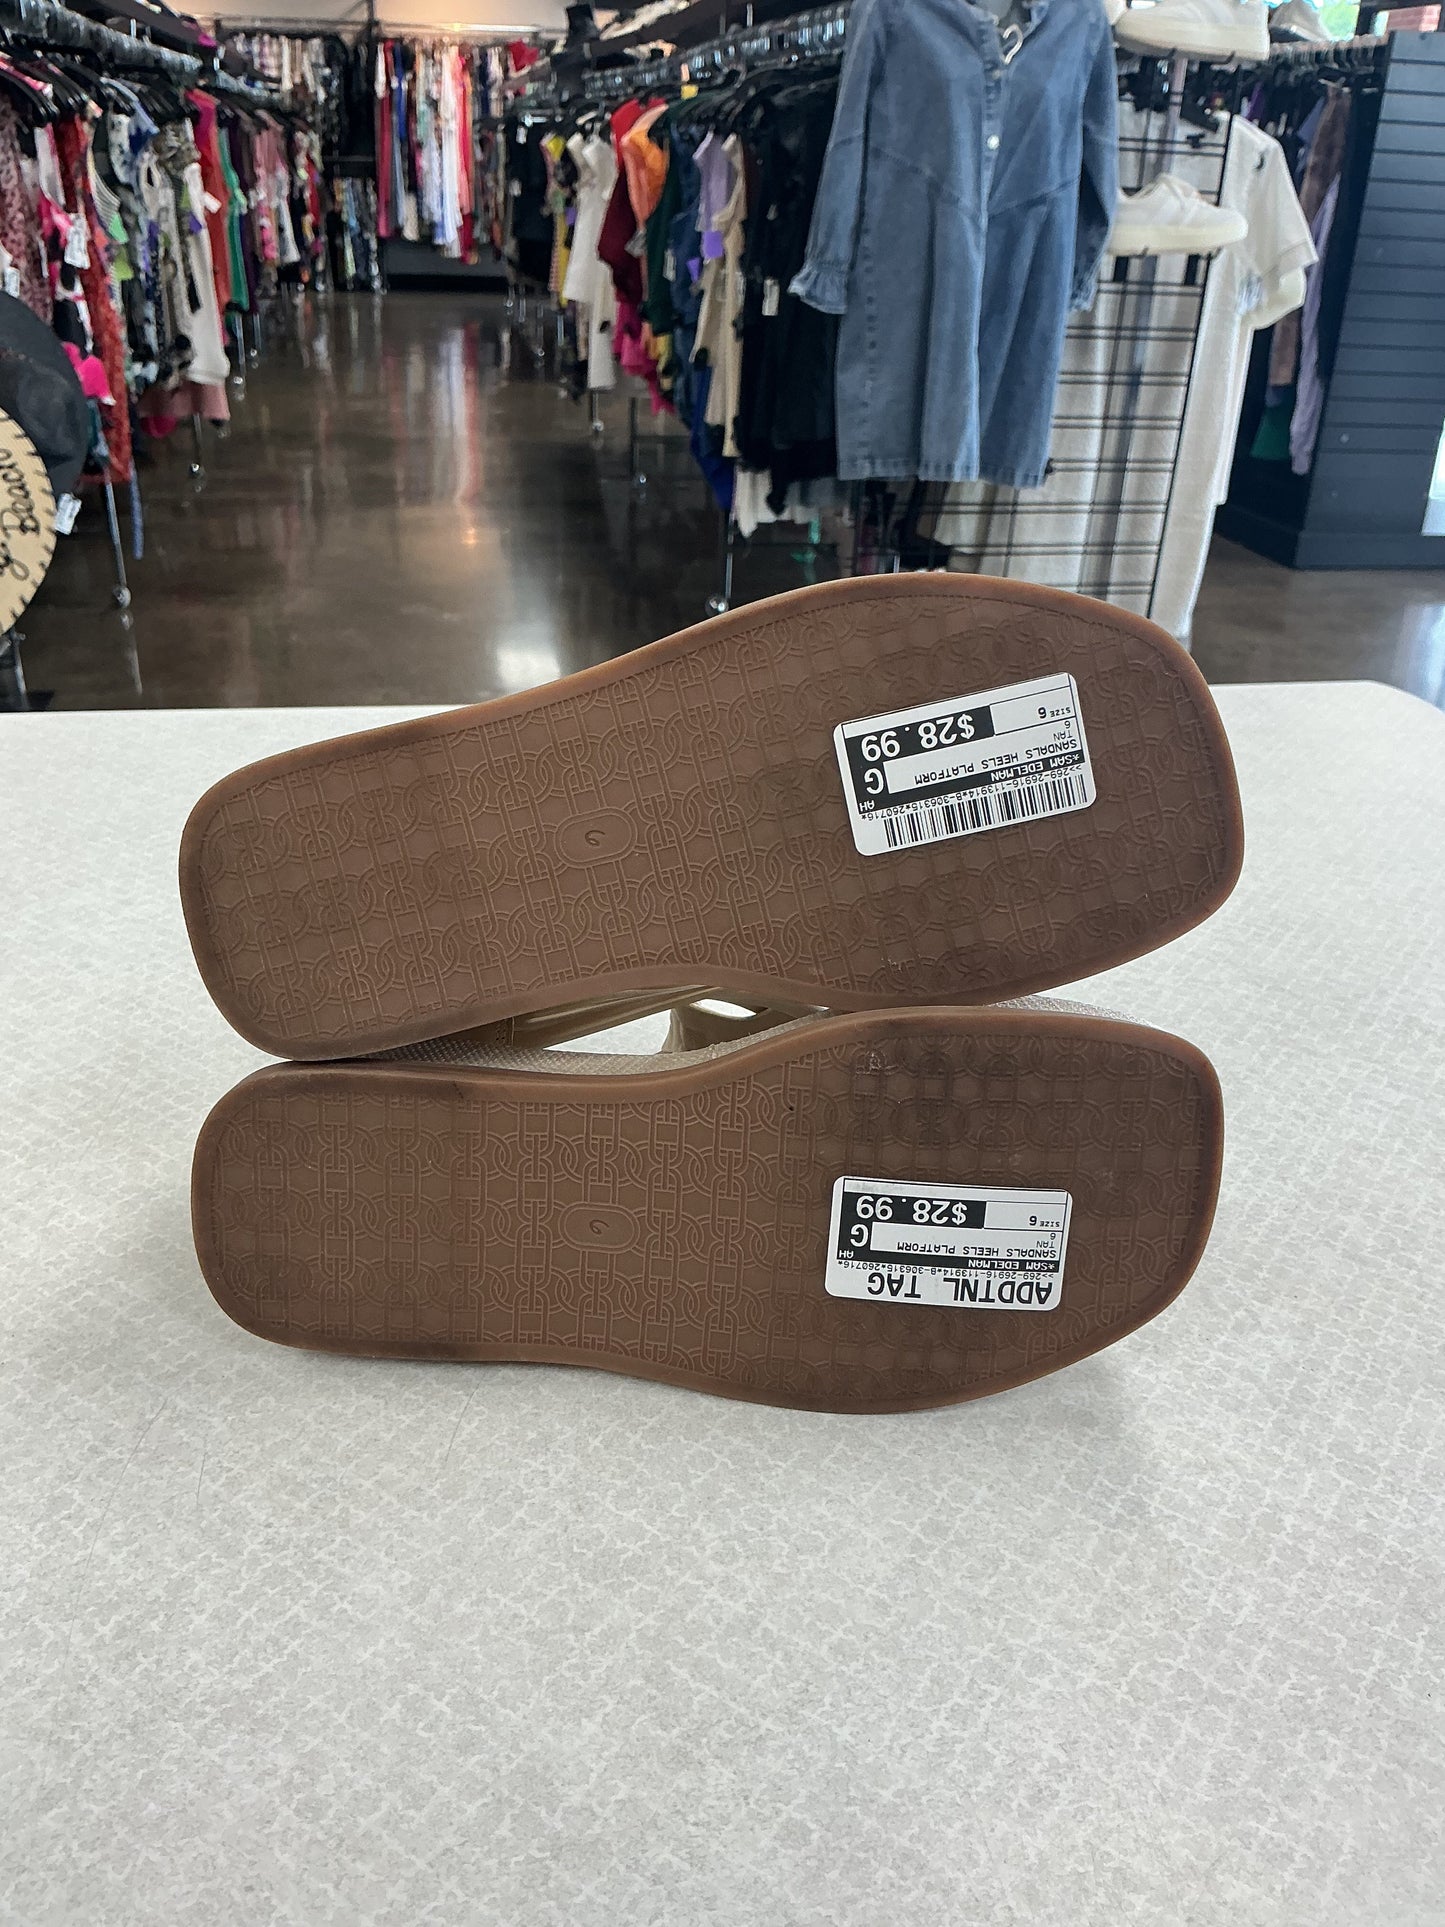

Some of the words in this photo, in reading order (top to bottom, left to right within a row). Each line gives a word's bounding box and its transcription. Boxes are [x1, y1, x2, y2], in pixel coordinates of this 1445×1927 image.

[1038, 707, 1047, 719] 6
[1050, 706, 1071, 717] SIZE
[1064, 720, 1071, 729] 6
[861, 714, 975, 761] $28.99
[1053, 730, 1073, 741] TAN
[1025, 739, 1077, 759] SANDALS
[981, 752, 1018, 769] HEELS
[914, 762, 974, 785] PLATFORM
[991, 762, 1043, 782] EDELMAN
[864, 768, 883, 794] G
[859, 800, 874, 812] AH
[856, 1195, 967, 1225] $28.99
[1029, 1216, 1037, 1226] 6
[850, 1224, 869, 1247] G
[1050, 1232, 1056, 1241] 6
[897, 1242, 956, 1254] PLATFORM
[1036, 1240, 1054, 1248] TAN
[839, 1250, 854, 1259] AH
[963, 1246, 999, 1256] HEELS
[1006, 1248, 1057, 1258] SANDALS
[968, 1259, 1019, 1269] EDELMAN
[867, 1273, 921, 1298] TAG
[943, 1278, 1052, 1304] ADDTNL
